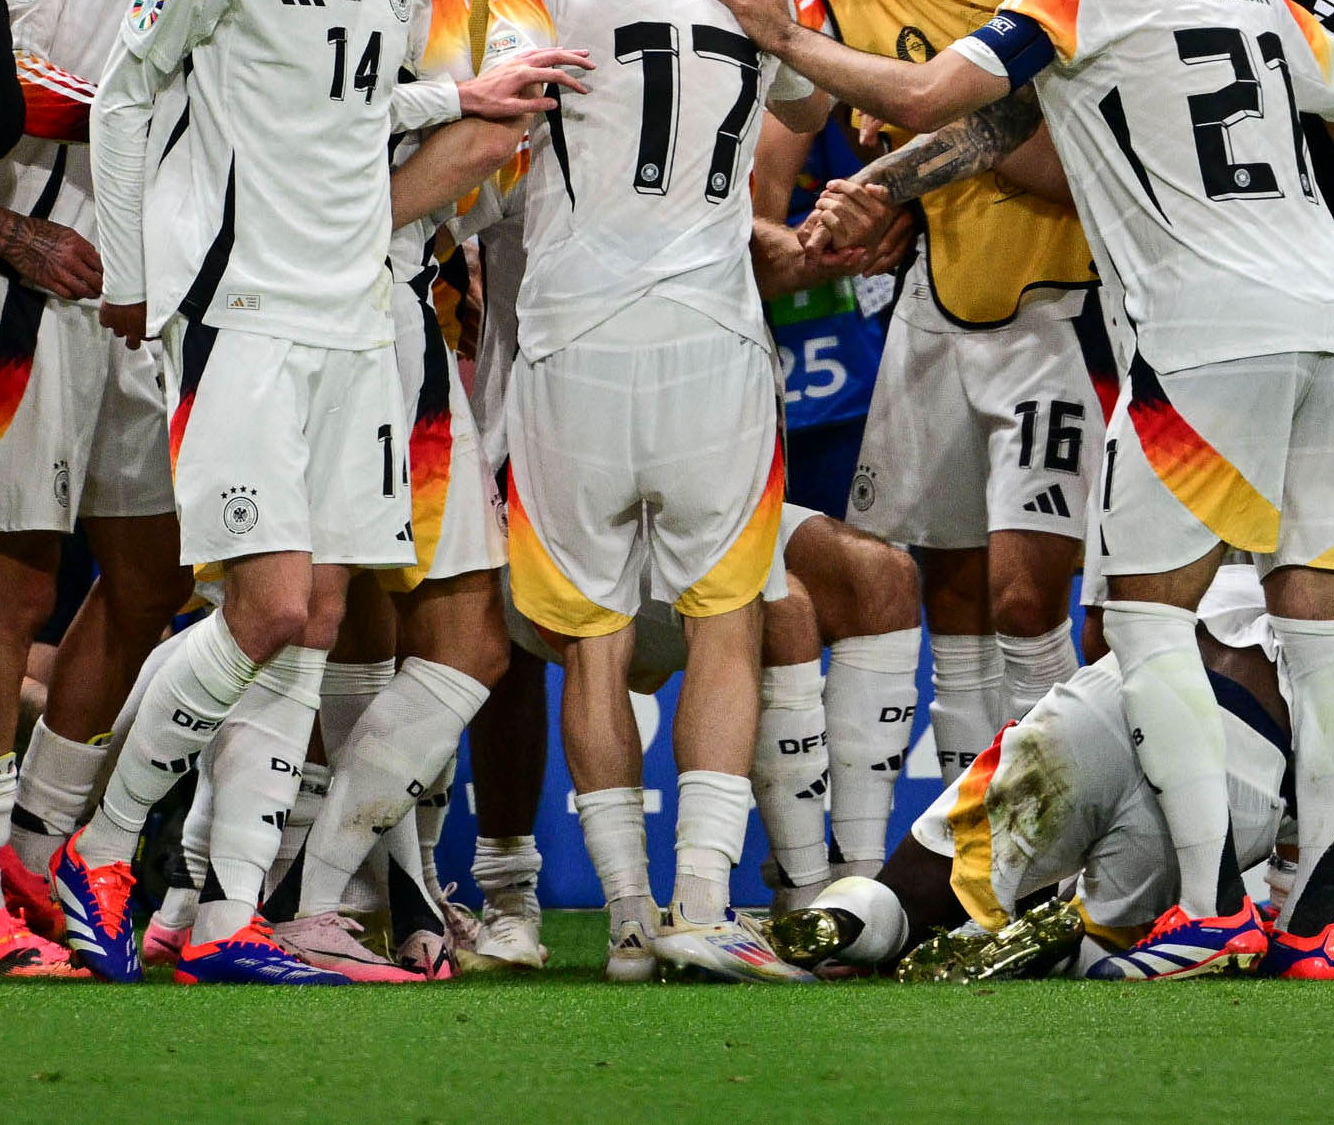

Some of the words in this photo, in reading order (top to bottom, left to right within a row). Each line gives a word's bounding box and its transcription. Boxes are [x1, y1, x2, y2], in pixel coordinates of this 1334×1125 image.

[327, 26, 382, 105] 14
[614, 21, 762, 204] 17
[1173, 28, 1319, 205] 21
[1014, 400, 1086, 476] 16
[172, 709, 224, 732] DF
